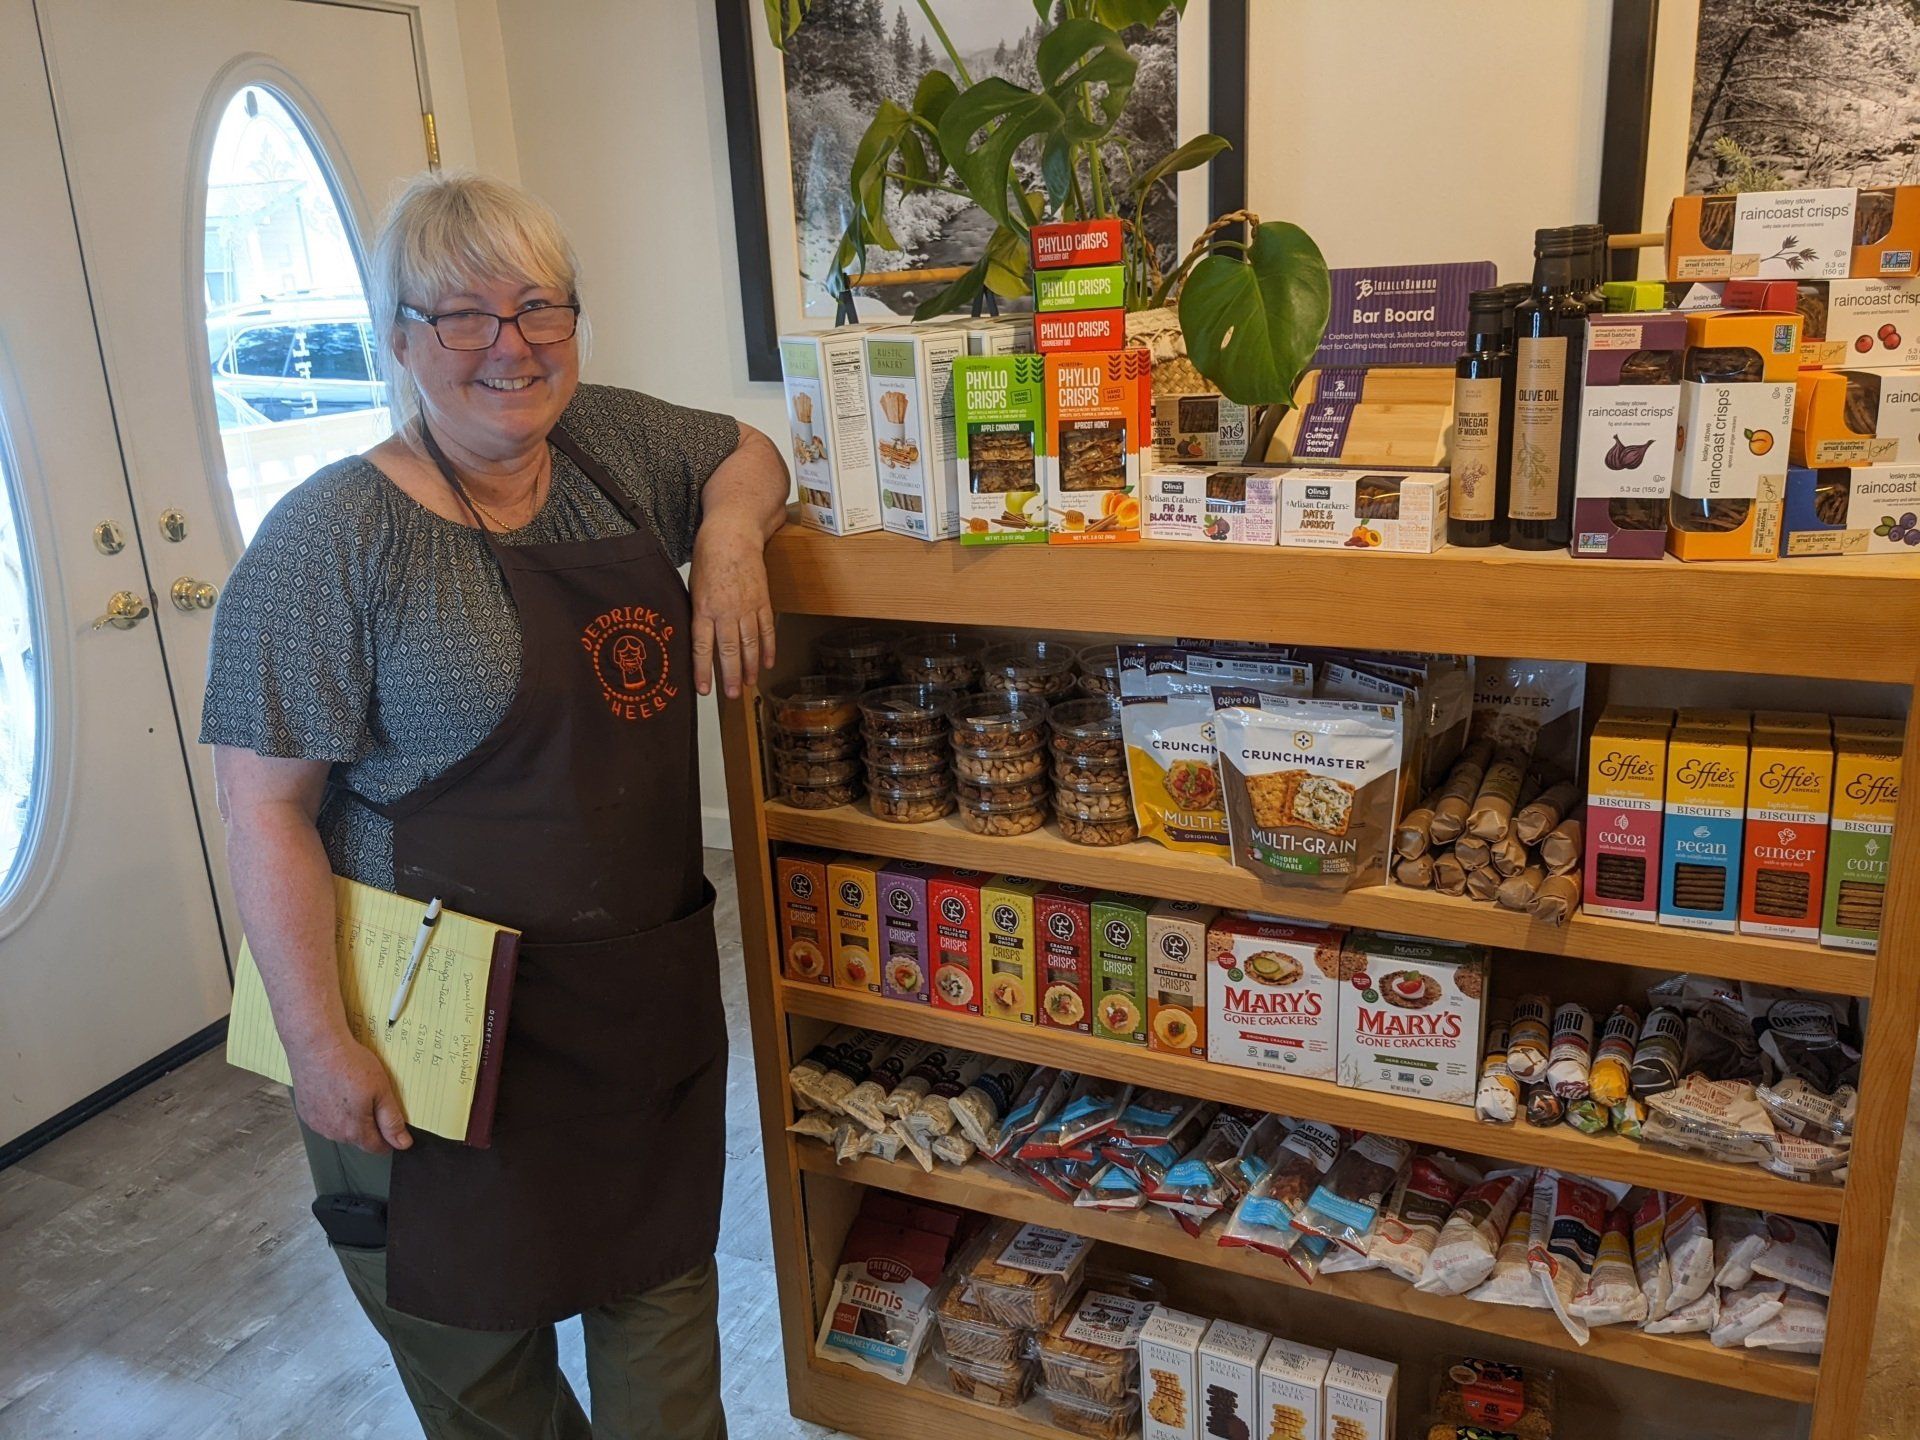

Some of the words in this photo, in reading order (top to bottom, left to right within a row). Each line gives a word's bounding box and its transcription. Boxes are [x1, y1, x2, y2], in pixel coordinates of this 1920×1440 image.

[1775, 198, 1794, 206] lesley
[1741, 206, 1803, 221] raincoast
[1808, 206, 1849, 220] crisps
[1038, 235, 1073, 254] PHYLLO
[1075, 232, 1109, 250] CRISPS
[1042, 281, 1075, 298] PHYLLO
[1078, 278, 1111, 295] CRISPS
[1834, 292, 1891, 306] raincoast
[1894, 291, 1920, 306] crisp
[1352, 309, 1380, 324] Bar
[1384, 306, 1435, 323] Board
[1041, 322, 1075, 339] PHYLLO
[1077, 321, 1110, 337] CRISPS
[1328, 332, 1353, 341] Crafted
[1354, 332, 1370, 340] from
[1371, 332, 1395, 340] Natural,
[1397, 330, 1435, 338] Sustainable
[1332, 342, 1343, 350] for
[1344, 342, 1367, 351] Cutting
[1390, 340, 1414, 349] Lemons
[1416, 340, 1430, 348] and
[1431, 340, 1450, 348] Other
[966, 370, 1008, 390] PHYLLO
[1058, 368, 1100, 387] PHYLLO
[967, 390, 1007, 409] CRISPS
[1059, 387, 1099, 407] CRISPS
[1519, 390, 1543, 401] OLIVE
[1545, 390, 1559, 401] OIL
[1886, 391, 1920, 404] rainc
[1588, 406, 1638, 417] raincoast
[1640, 407, 1674, 419] crisps
[1716, 389, 1731, 429] crisps
[981, 424, 995, 432] APPLE
[996, 423, 1020, 432] CINNAMON
[1094, 421, 1109, 429] HONEY
[1458, 418, 1489, 428] VINEGAR
[1458, 428, 1463, 436] OF
[1464, 428, 1488, 436] MODENA
[1704, 423, 1712, 442] stowe
[1701, 444, 1710, 462] lesley
[1708, 433, 1726, 494] raincoast
[1308, 488, 1329, 496] Olina's
[1642, 486, 1656, 494] (150
[1657, 486, 1665, 494] g)
[1856, 482, 1917, 494] raincoast
[1148, 494, 1169, 502] Artisan
[1162, 504, 1175, 512] FIG
[1178, 504, 1184, 513] &
[1289, 500, 1314, 509] Artisan
[1316, 502, 1346, 510] Crackers
[1150, 513, 1174, 522] BLACK
[1176, 514, 1198, 523] OLIVE
[1303, 510, 1324, 519] DATE
[1326, 510, 1333, 519] &
[1300, 520, 1336, 530] APRICOT
[581, 606, 674, 652] JEDRICK'S
[1218, 696, 1241, 707] Olive
[1242, 696, 1255, 704] Oil
[1473, 692, 1550, 708] CHMASTER
[1152, 740, 1218, 755] CRUNCH
[1242, 750, 1366, 770] CRUNCHMASTER
[1598, 752, 1655, 781] Effie's
[1676, 758, 1735, 789] Effie's
[1760, 763, 1821, 795] Effie's
[1846, 773, 1899, 805] Effie
[1600, 798, 1651, 809] BISCUITS
[1676, 806, 1731, 817] BISCUITS
[1760, 810, 1816, 823] BISCUITS
[1165, 810, 1230, 832] MULTI-S
[1844, 821, 1895, 834] BISCUI
[1184, 833, 1218, 841] ORIGINAL
[1251, 827, 1357, 855] MULTI-GRAIN
[1599, 831, 1646, 847] cocoa
[1676, 840, 1727, 856] pecan
[1270, 858, 1303, 871] VEGETABLE
[1273, 853, 1299, 864] GARDEN
[791, 910, 816, 924] CRISPS
[840, 918, 866, 932] CRISPS
[890, 928, 916, 943] CRISPS
[995, 934, 1018, 943] TOASTED
[940, 937, 967, 952] CRISPS
[1050, 943, 1074, 951] CRACKED
[993, 946, 1020, 961] CRISPS
[1048, 954, 1077, 970] CRISPS
[1104, 960, 1133, 976] CRISPS
[1156, 969, 1178, 977] GLUTEN
[1180, 972, 1194, 980] FREE
[1160, 976, 1190, 993] CRISPS
[1223, 985, 1322, 1016] MARY'S
[1224, 1014, 1256, 1026] GONE
[1259, 1015, 1318, 1026] CRACKERS
[1357, 1006, 1462, 1039] MARY'S
[1246, 1034, 1269, 1042] ORIGINAL
[1356, 1035, 1391, 1048] GONE
[1394, 1037, 1456, 1048] CRACKERS
[1400, 1059, 1427, 1068] CRACKERS
[1300, 1124, 1339, 1149] ARTUFO
[1788, 1146, 1824, 1154] PRESERVATIVES
[852, 1283, 904, 1310] minis
[834, 1333, 871, 1350] HUMANELY
[872, 1343, 897, 1357] RAISED
[1150, 1346, 1180, 1359] RUSTIC
[1150, 1353, 1181, 1367] BAKERY
[1210, 1360, 1240, 1372] RUSTIC
[1210, 1366, 1241, 1380] BAKERY
[1272, 1382, 1303, 1395] RUSTIC
[1272, 1388, 1305, 1401] BAKERY
[1336, 1393, 1368, 1406] RUSTIC
[1336, 1400, 1370, 1413] BAKERY
